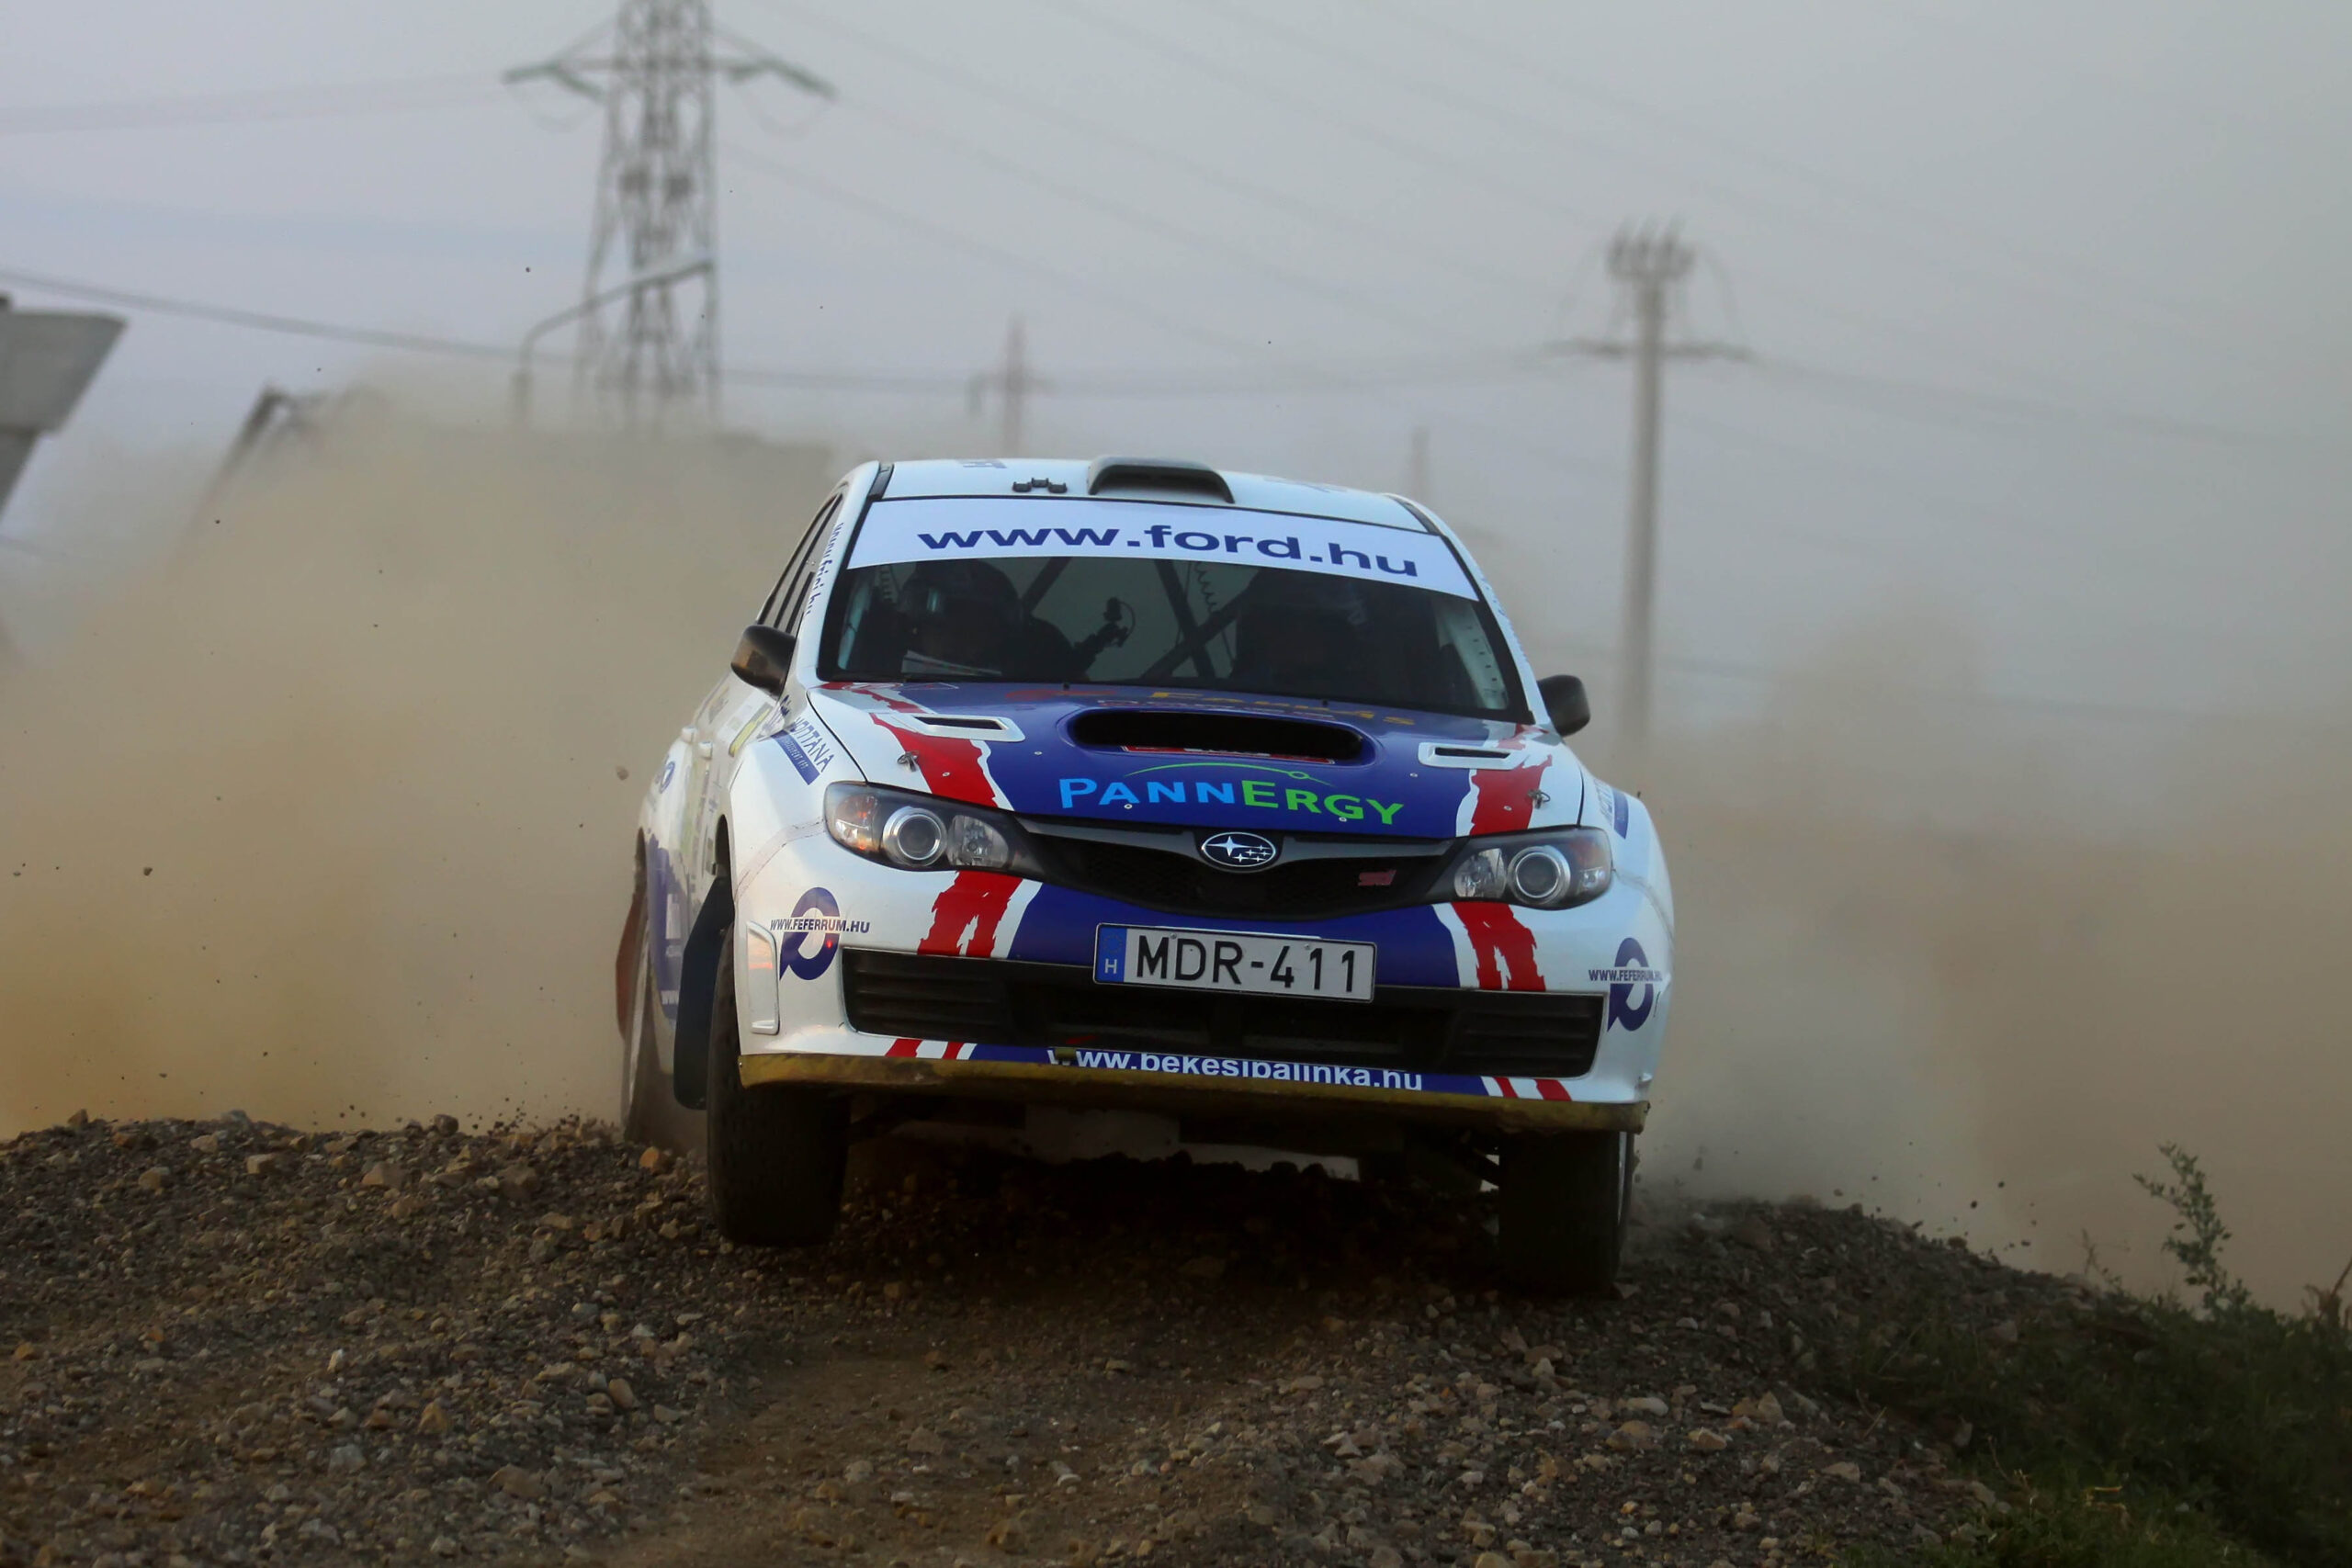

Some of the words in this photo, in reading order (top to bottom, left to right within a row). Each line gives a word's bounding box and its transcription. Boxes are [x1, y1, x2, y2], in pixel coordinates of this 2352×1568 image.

[917, 524, 1419, 577] www.ford.hu
[1058, 778, 1405, 826] PANNERGY
[770, 919, 871, 933] WWW.FEFERRUM.HU
[1103, 958, 1117, 975] H
[1136, 935, 1355, 993] MDR-411
